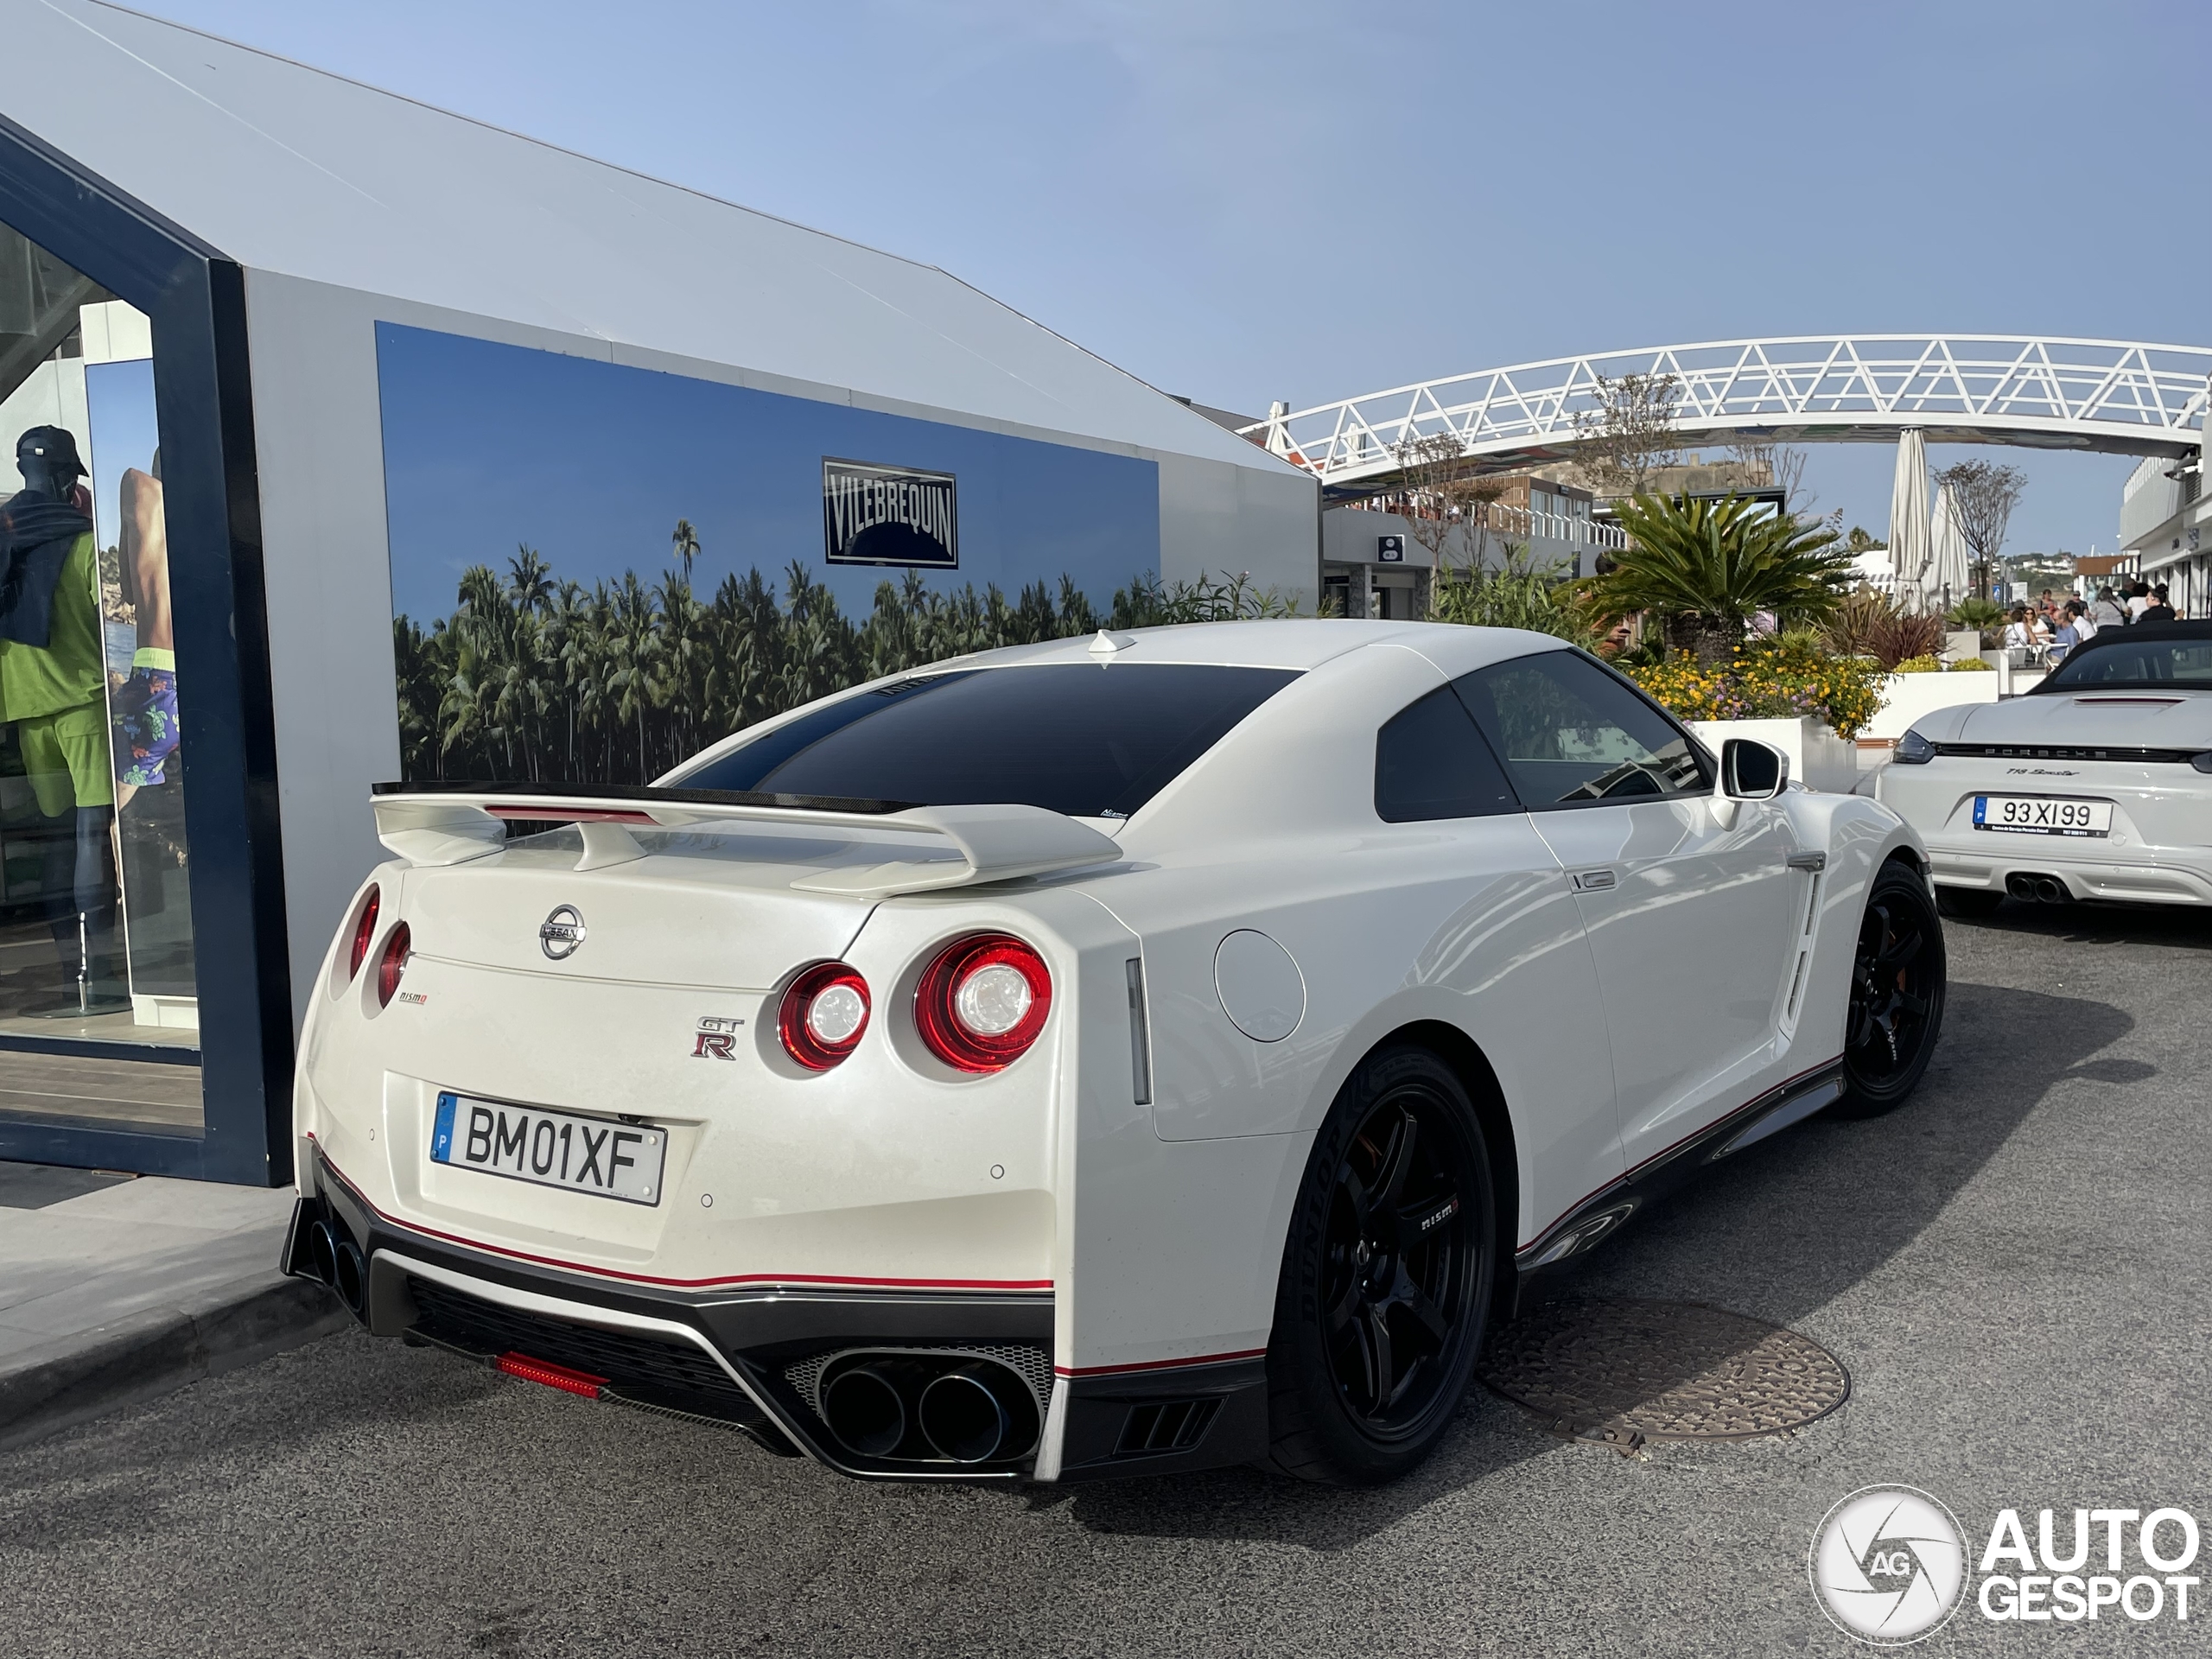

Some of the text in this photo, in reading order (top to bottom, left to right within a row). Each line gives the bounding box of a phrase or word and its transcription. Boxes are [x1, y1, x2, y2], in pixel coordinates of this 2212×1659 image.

[830, 474, 952, 556] VILEBREQUIN
[543, 926, 578, 938] NISSAN
[399, 991, 428, 1002] nismo
[438, 1135, 447, 1149] P
[466, 1106, 643, 1189] BM01XF
[1302, 1124, 1341, 1322] DUNLOP
